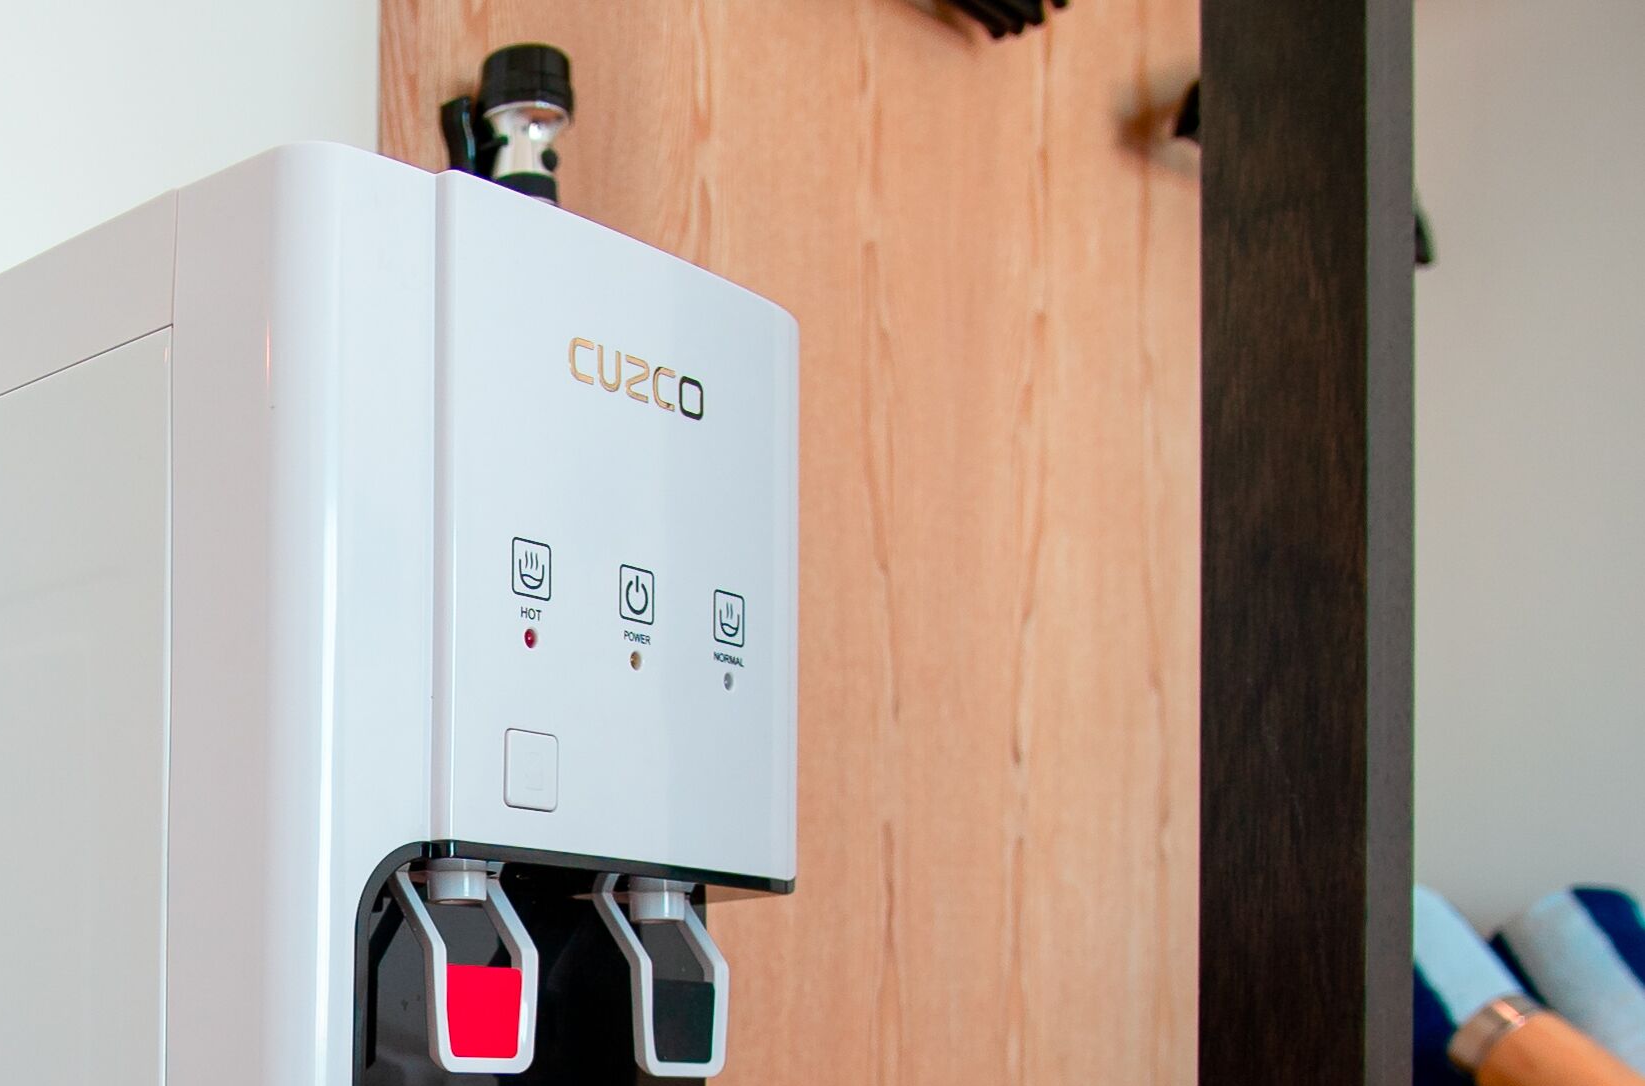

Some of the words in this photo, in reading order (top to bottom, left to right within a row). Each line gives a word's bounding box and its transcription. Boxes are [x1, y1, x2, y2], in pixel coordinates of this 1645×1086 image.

[568, 337, 704, 420] CUZCO
[520, 606, 542, 621] HOT
[624, 630, 651, 645] POWER
[713, 651, 744, 667] NORMAL
